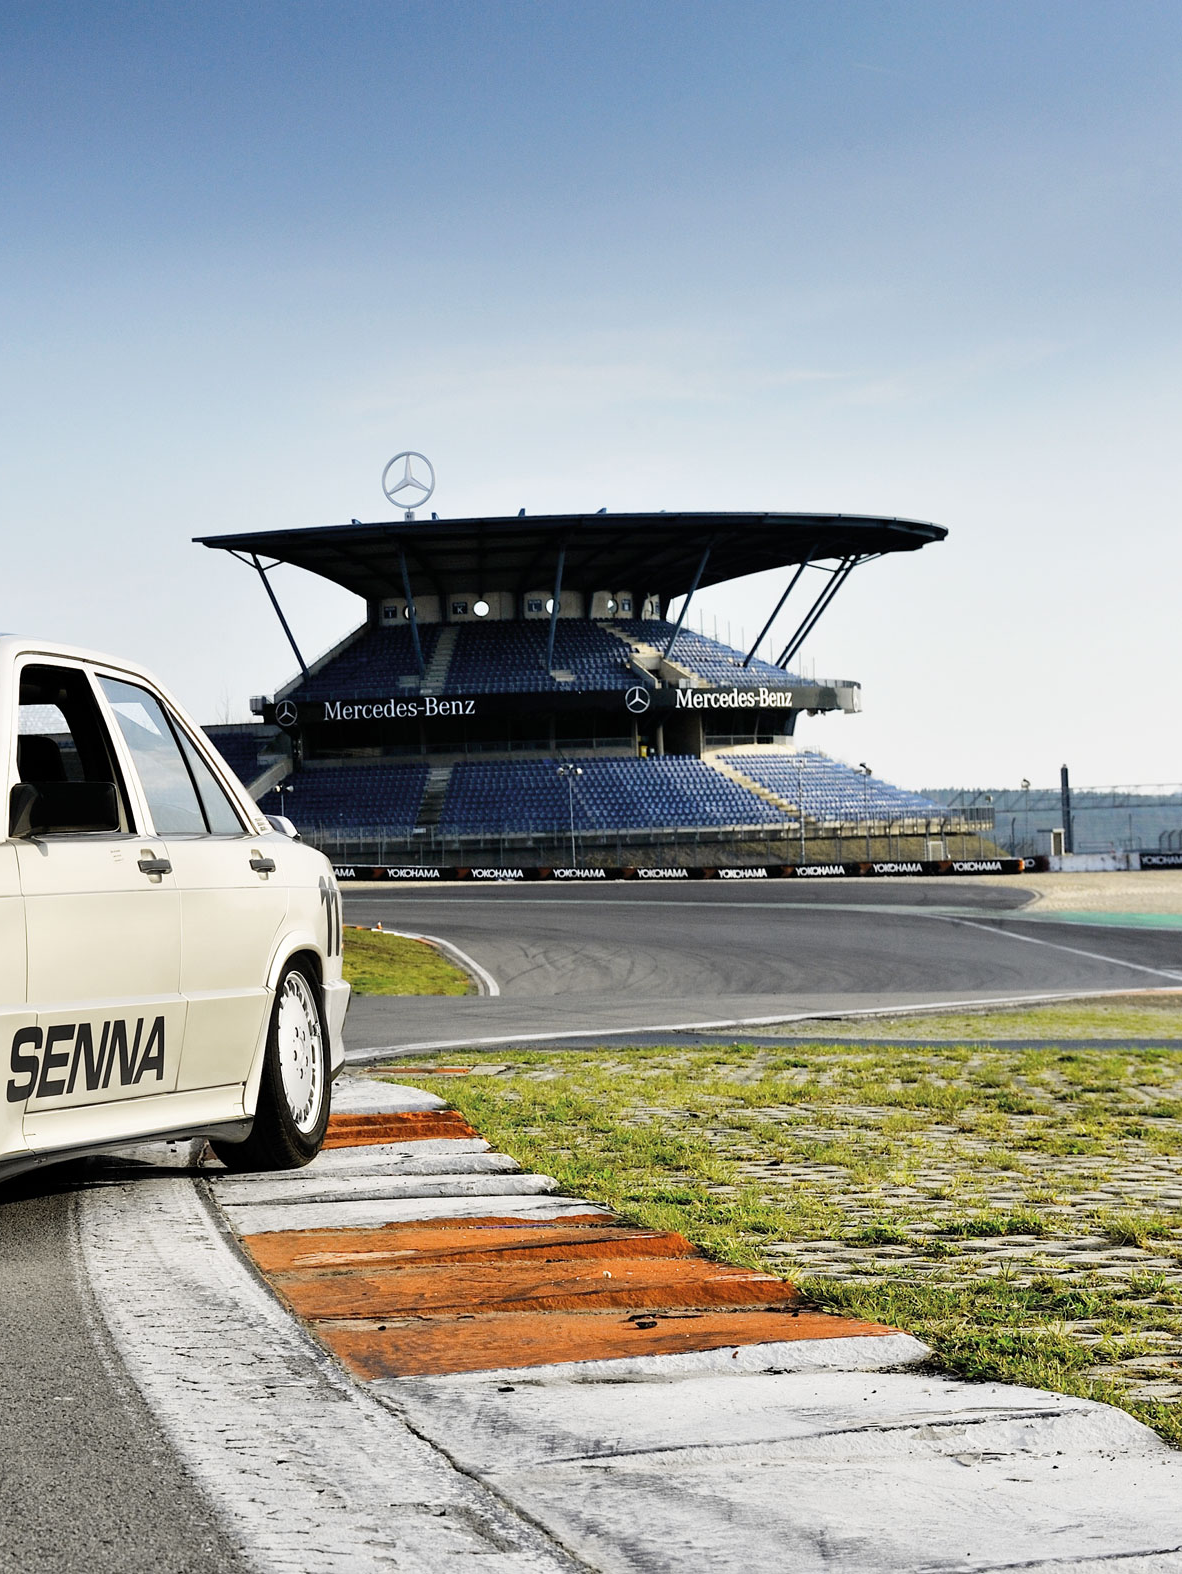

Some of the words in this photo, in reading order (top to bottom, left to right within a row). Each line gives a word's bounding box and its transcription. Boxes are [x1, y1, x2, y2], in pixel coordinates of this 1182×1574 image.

[675, 688, 793, 709] Mercedes-Benz
[323, 697, 476, 721] Mercedes-Benz
[794, 865, 846, 876] YOKOHAMA
[872, 863, 923, 873] YOKOHAMA
[952, 861, 1003, 872] YOKOHAMA
[386, 868, 440, 878] YOKOHAMA
[471, 868, 525, 878] YOKOHAMA
[552, 868, 606, 878] YOKOHAMA
[636, 868, 689, 878] YOKOHAMA
[717, 867, 768, 879] YOKOHAMA
[6, 1015, 165, 1103] SENNA
